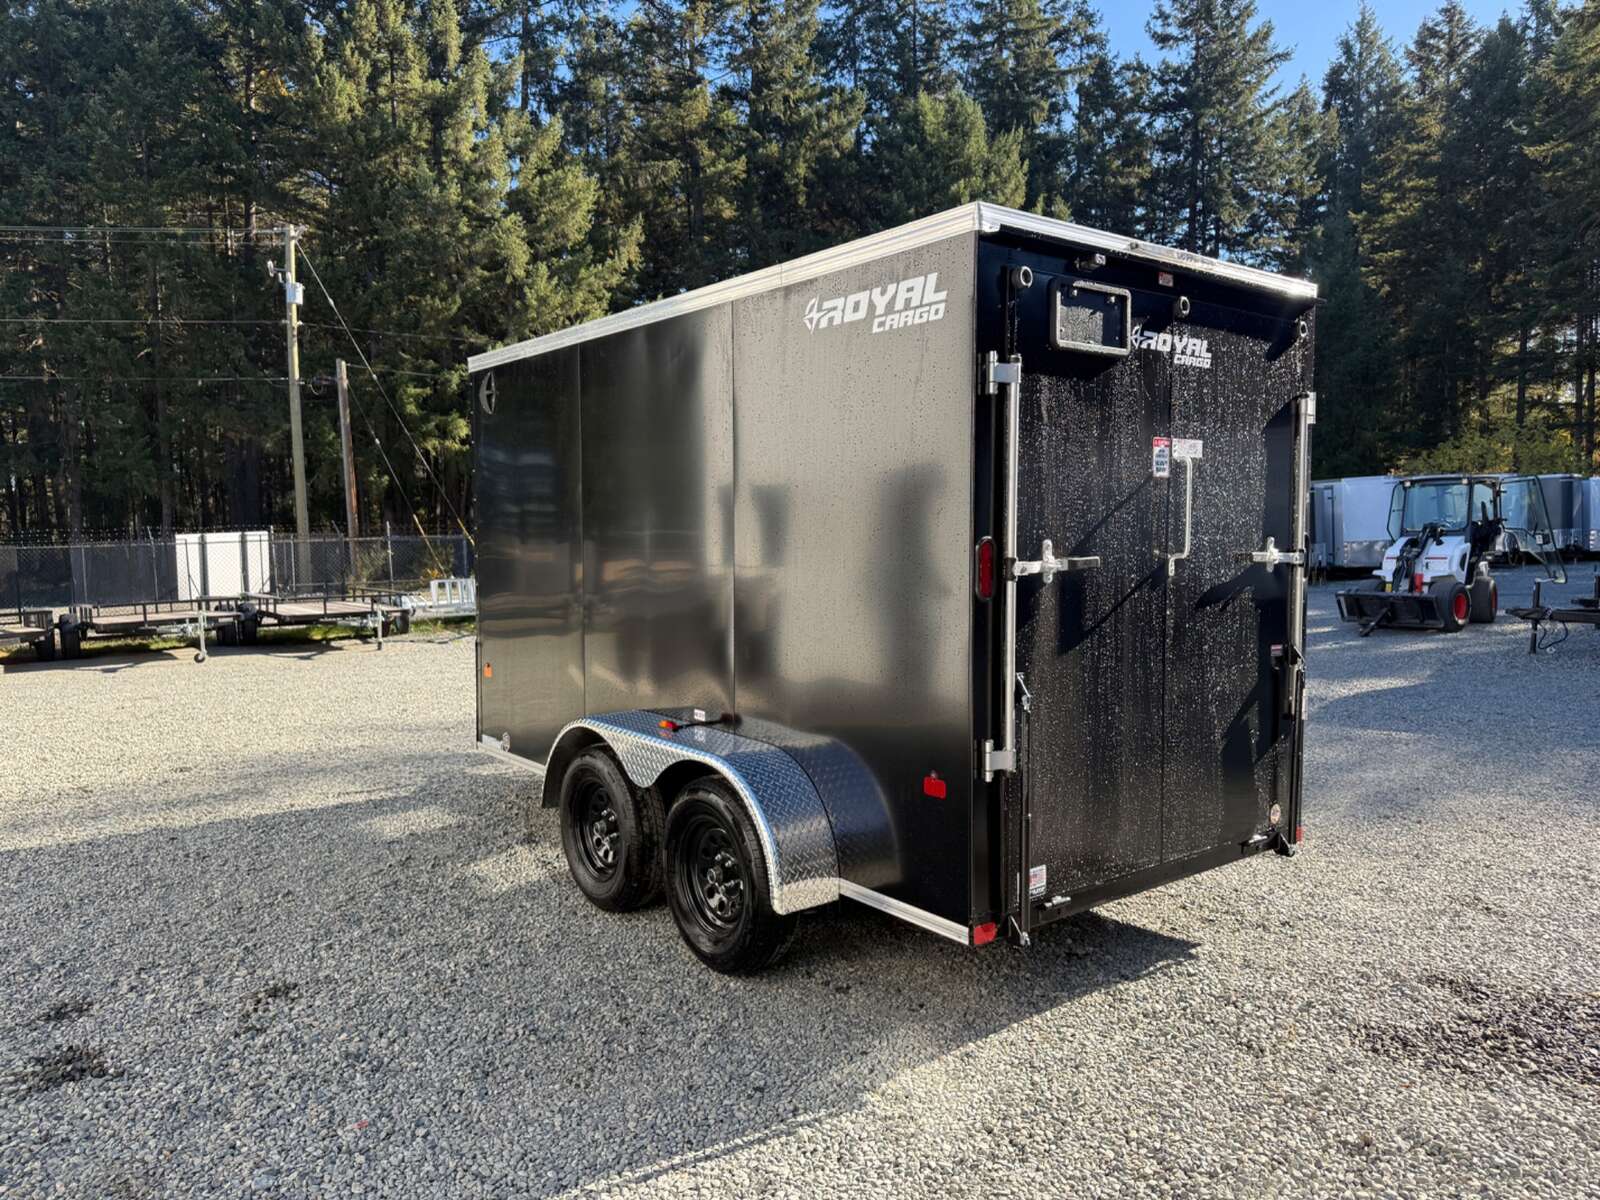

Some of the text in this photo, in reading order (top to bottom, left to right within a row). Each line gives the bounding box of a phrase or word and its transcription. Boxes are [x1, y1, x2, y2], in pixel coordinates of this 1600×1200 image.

[818, 272, 948, 329] ROYAL
[872, 302, 946, 334] CARGO
[1140, 330, 1212, 358] ROYAL
[1173, 353, 1212, 369] CARGO
